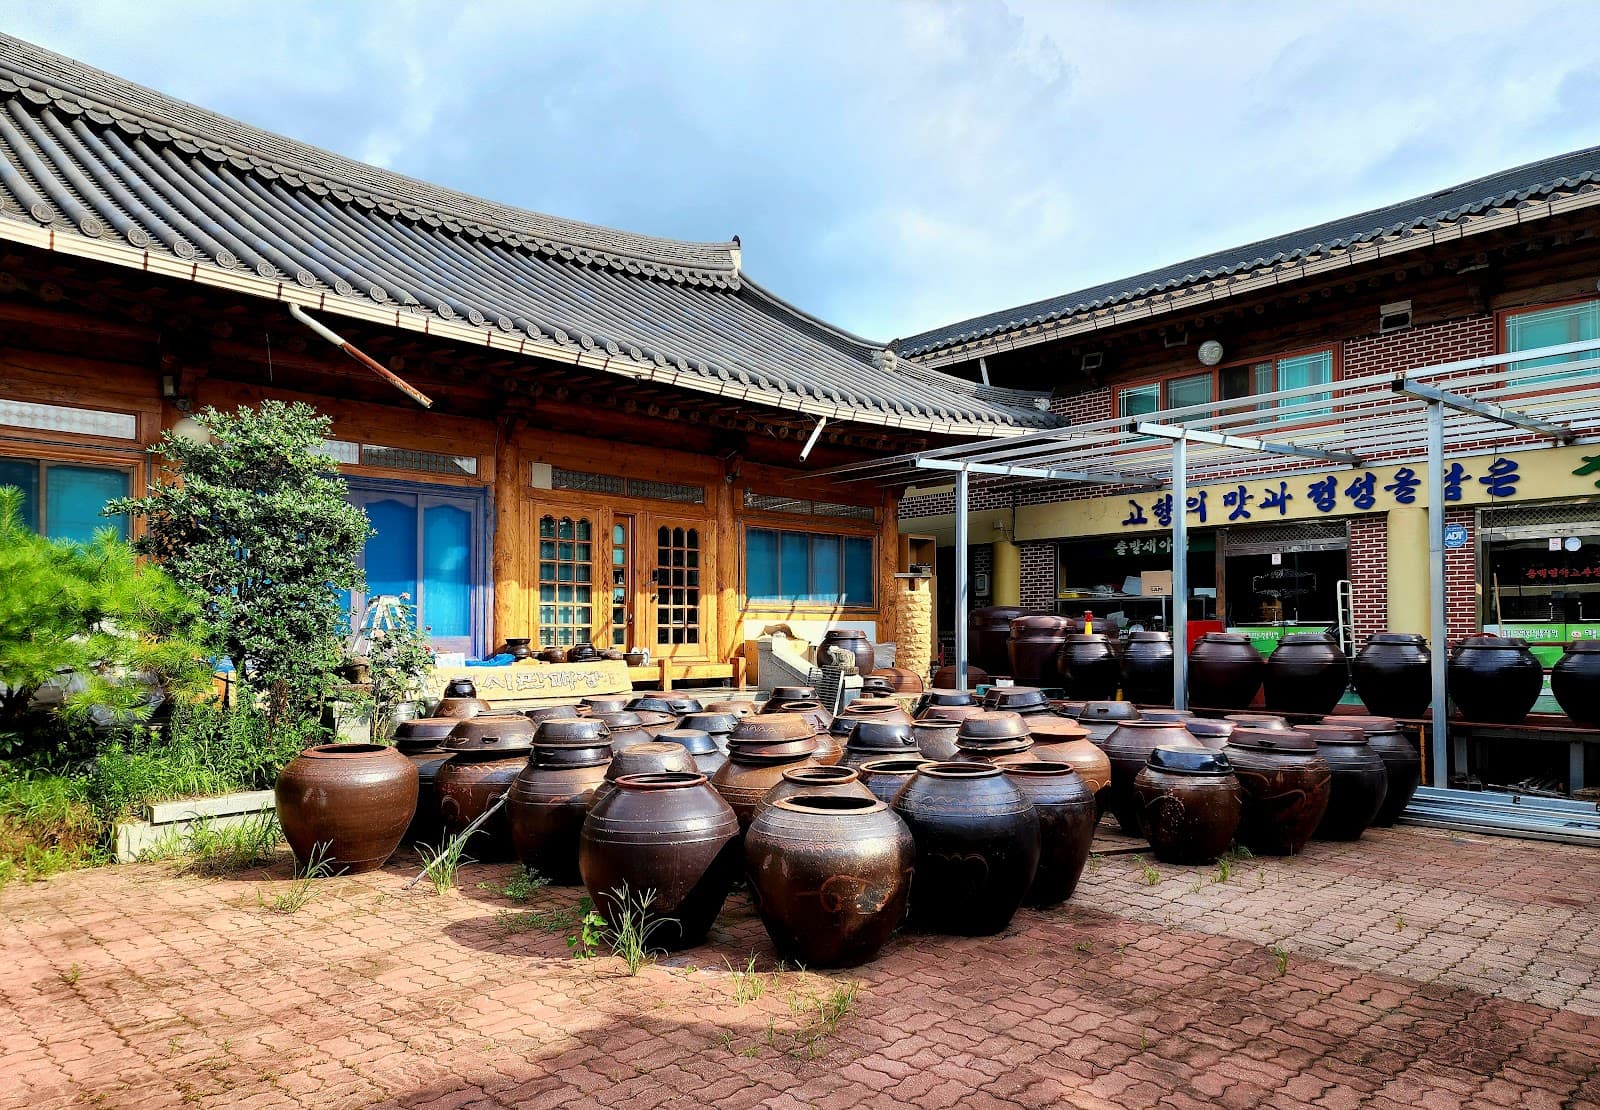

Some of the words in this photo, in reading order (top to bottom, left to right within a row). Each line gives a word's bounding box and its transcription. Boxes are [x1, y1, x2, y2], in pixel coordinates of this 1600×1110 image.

[1121, 490, 1208, 527] 고향의
[1222, 481, 1293, 521] 맛과
[1445, 530, 1464, 541] ADT
